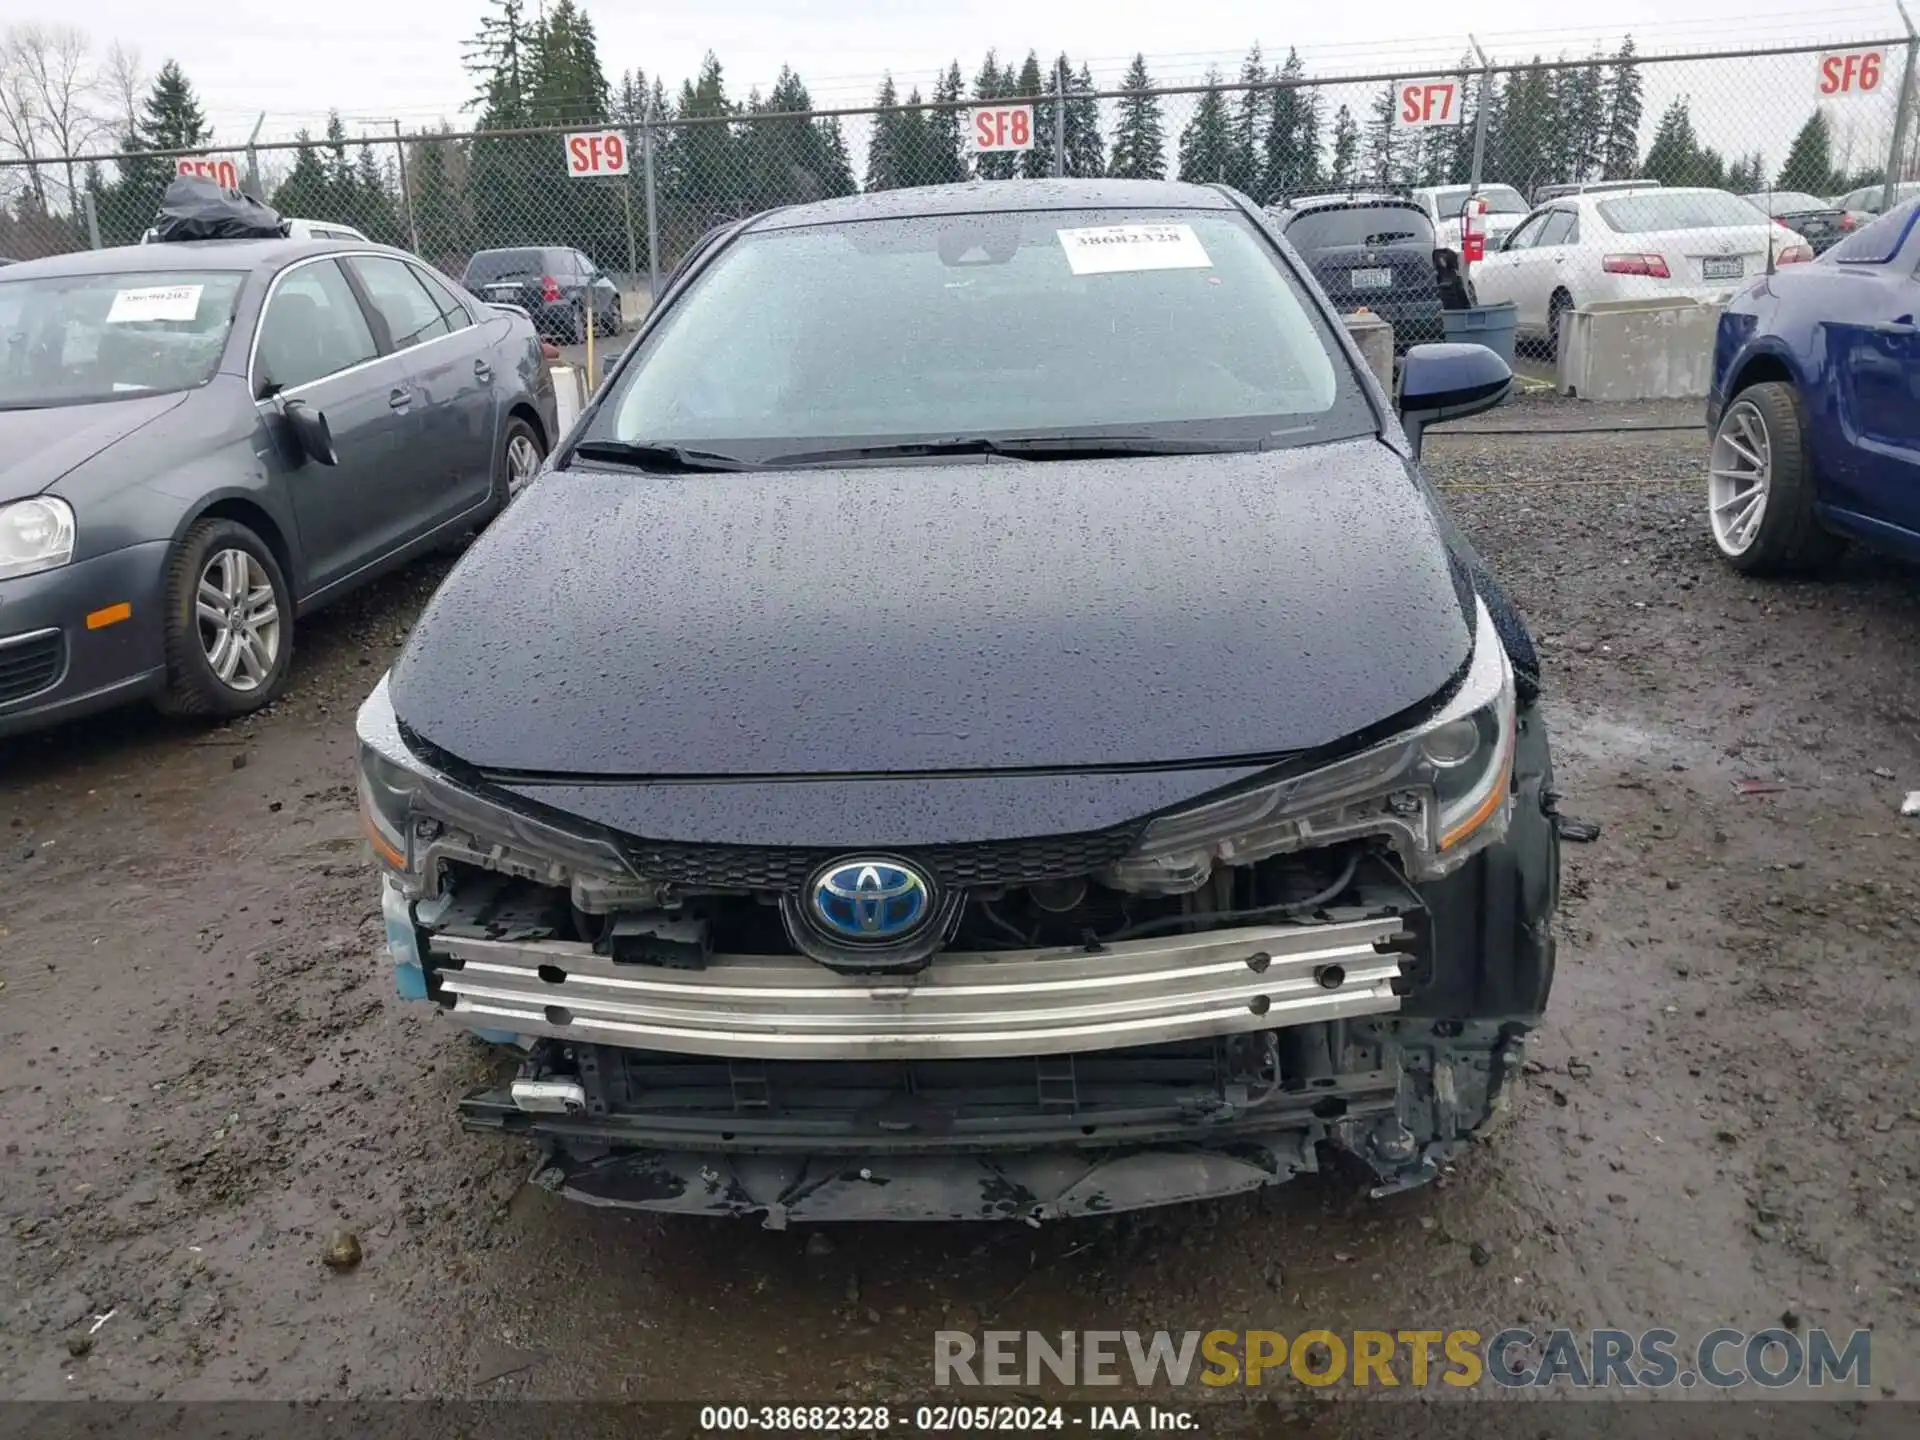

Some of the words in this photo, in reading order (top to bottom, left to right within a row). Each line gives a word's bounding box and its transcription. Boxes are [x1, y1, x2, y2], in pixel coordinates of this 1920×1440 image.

[1820, 52, 1881, 94] SF6
[1402, 84, 1454, 122] SF7
[976, 110, 1029, 147] SF8
[570, 136, 623, 171] SF9
